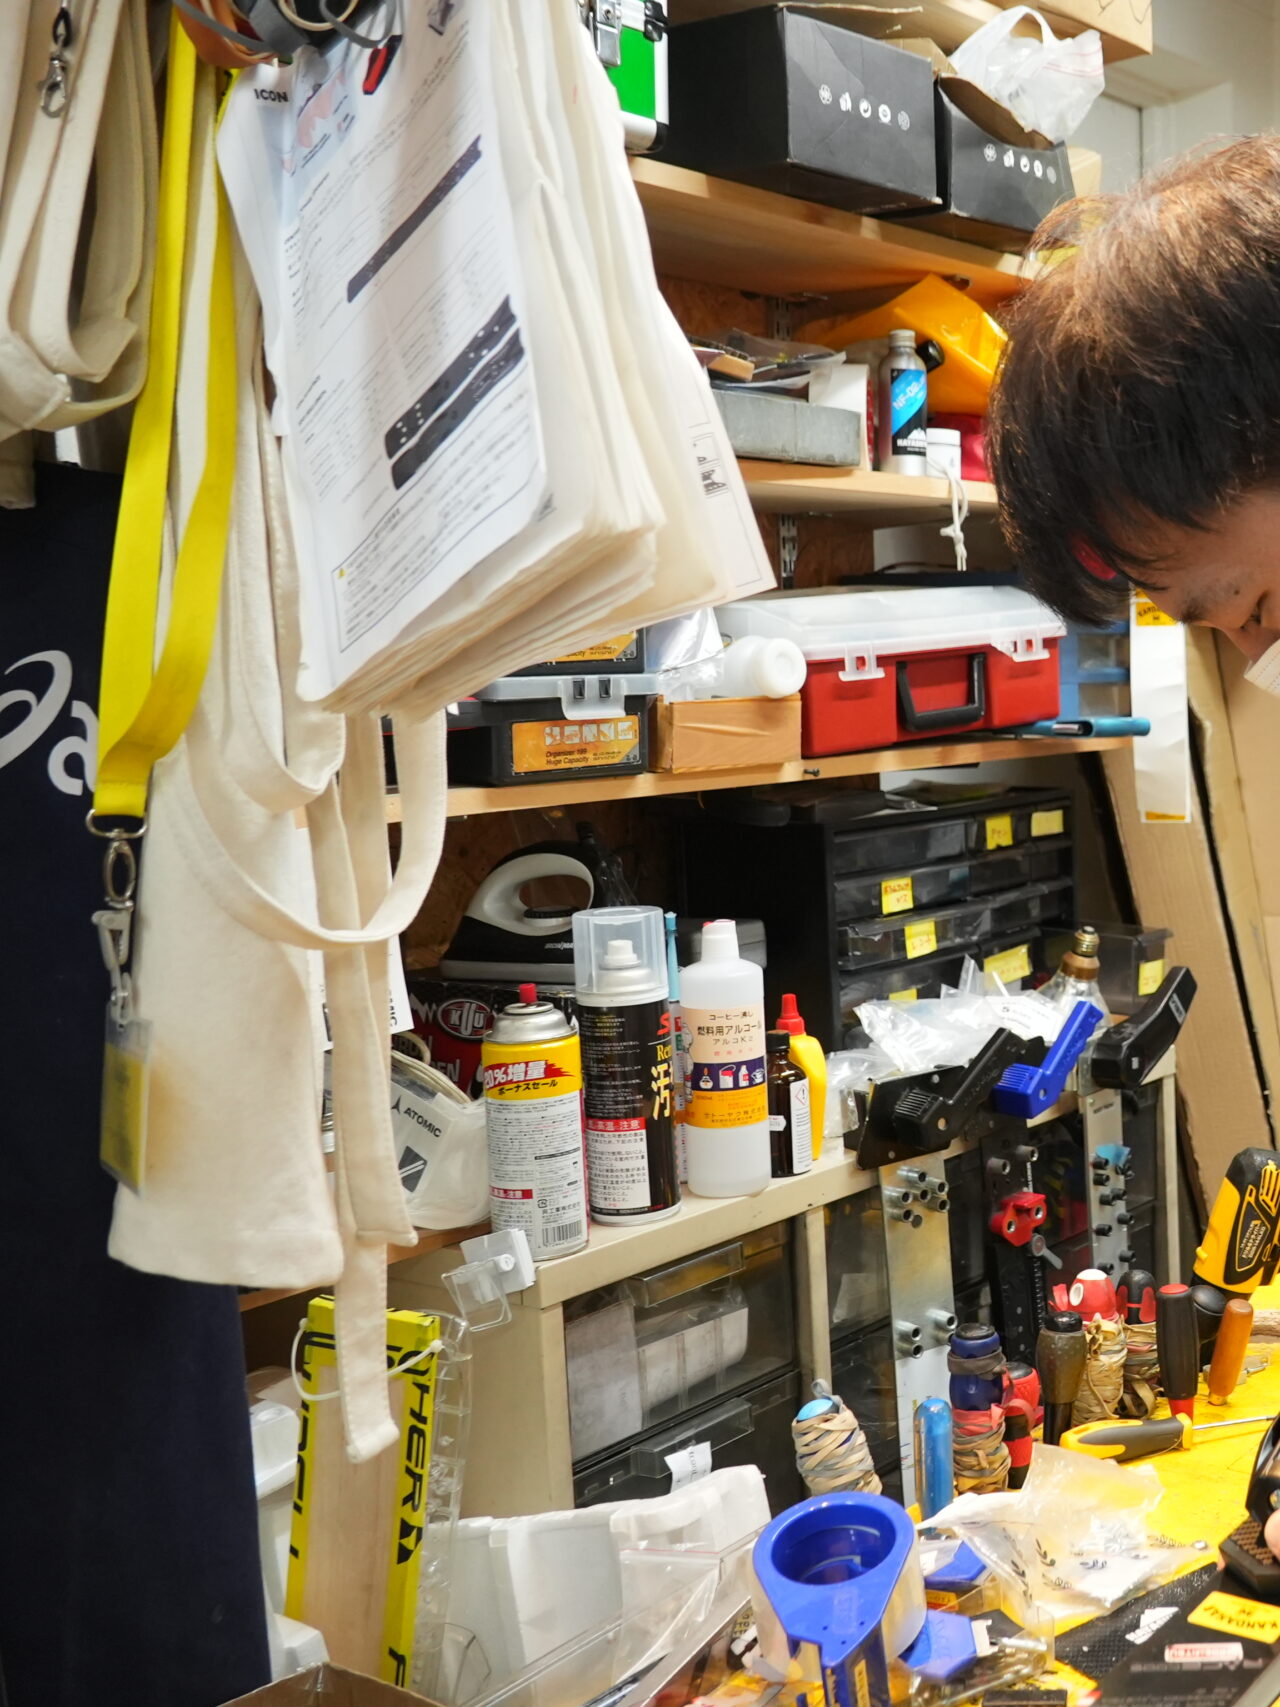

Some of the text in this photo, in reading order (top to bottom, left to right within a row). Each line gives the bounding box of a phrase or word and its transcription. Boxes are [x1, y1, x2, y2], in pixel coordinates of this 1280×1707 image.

[253, 88, 289, 103] ICON
[545, 749, 575, 758] Organizer
[546, 756, 589, 767] Huge Capacity
[497, 1078, 559, 1096] ボーナスセール
[403, 1106, 442, 1139] ATOMIC
